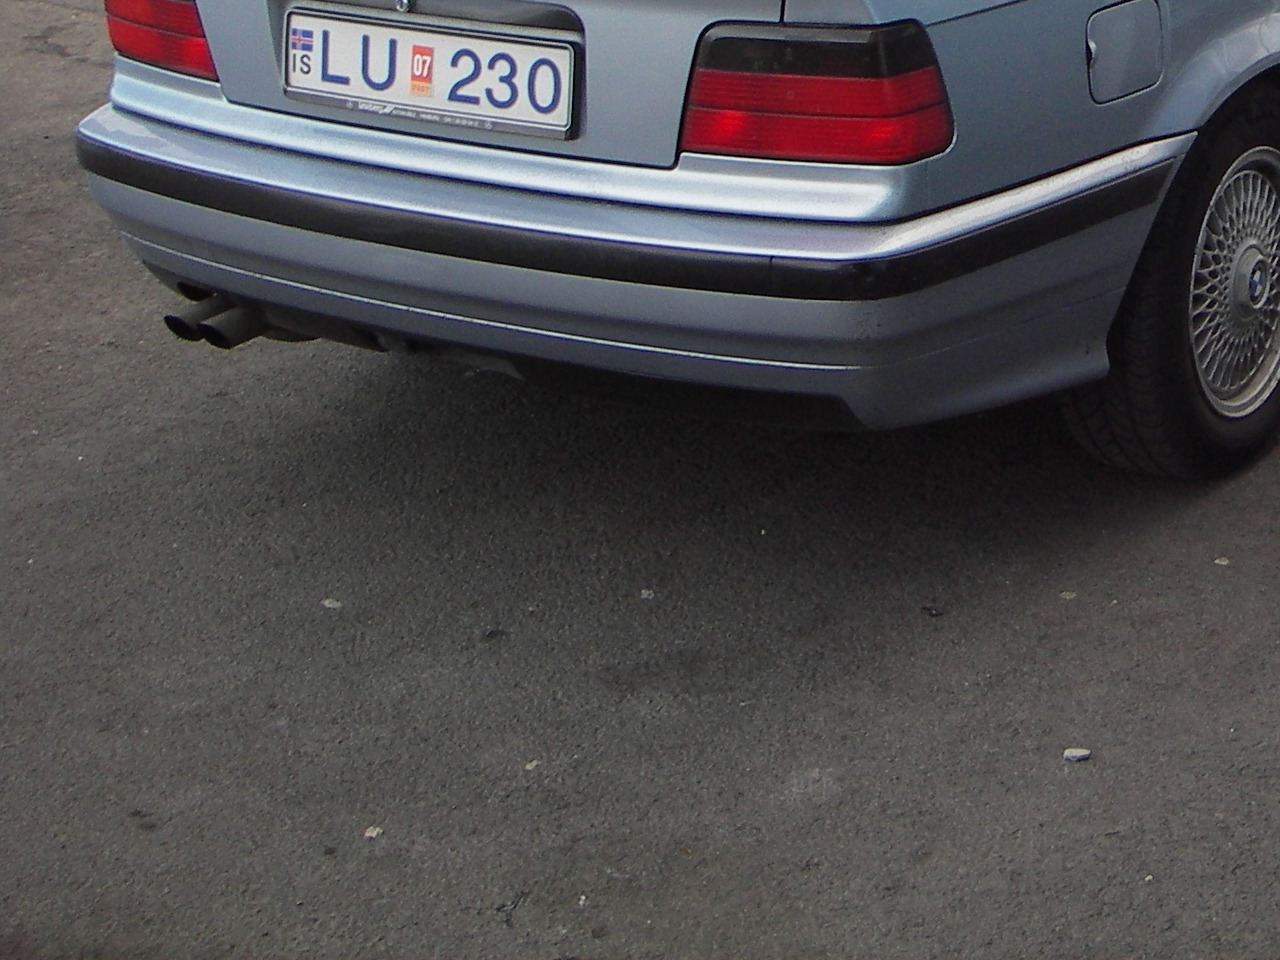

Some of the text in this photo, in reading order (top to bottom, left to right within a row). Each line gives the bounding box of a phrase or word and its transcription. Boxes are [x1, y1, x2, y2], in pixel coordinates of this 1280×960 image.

[292, 53, 312, 75] IS
[321, 29, 398, 91] LU
[447, 48, 562, 114] 230
